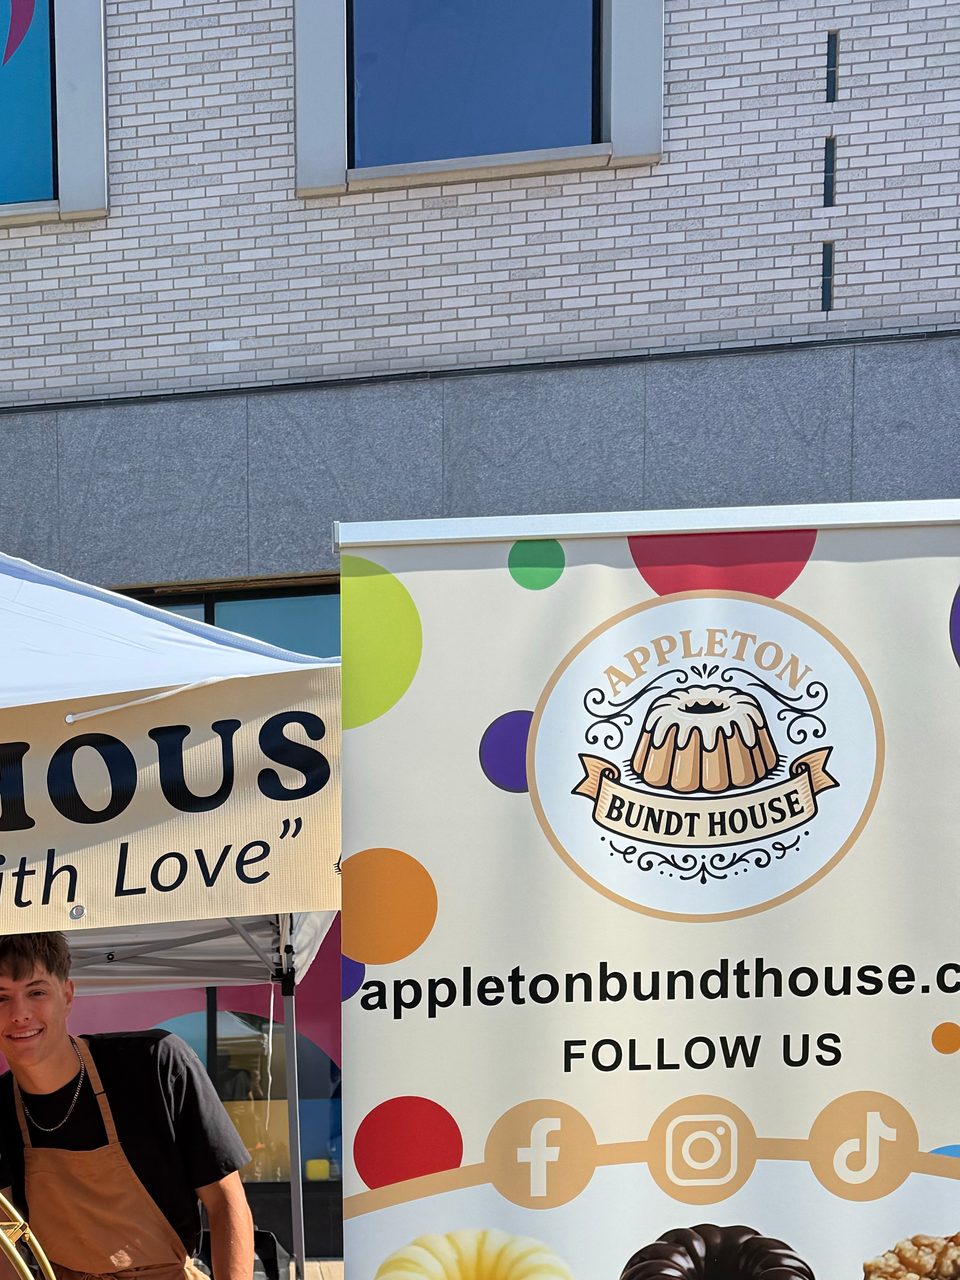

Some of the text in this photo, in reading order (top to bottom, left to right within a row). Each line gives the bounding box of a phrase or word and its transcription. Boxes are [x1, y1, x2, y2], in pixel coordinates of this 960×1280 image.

[603, 628, 813, 697] APPLETON
[605, 789, 805, 838] BUNDT HOUSE
[360, 957, 960, 1020] appletonbundthouse.c
[563, 1032, 843, 1073] FOLLOW US
